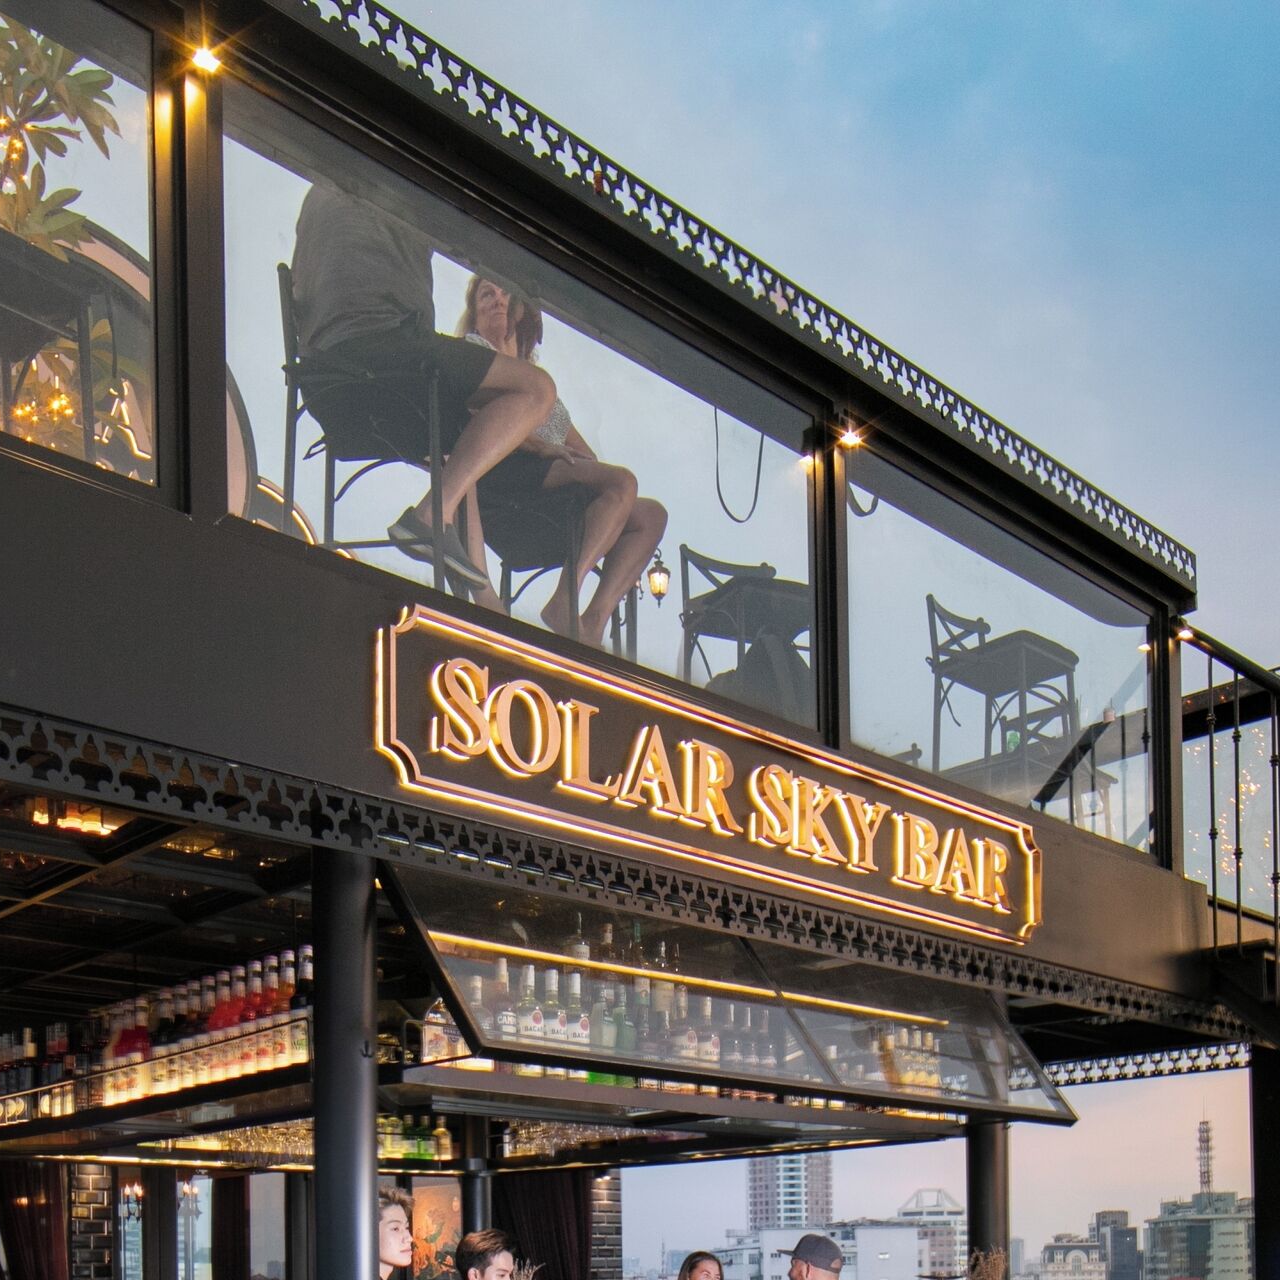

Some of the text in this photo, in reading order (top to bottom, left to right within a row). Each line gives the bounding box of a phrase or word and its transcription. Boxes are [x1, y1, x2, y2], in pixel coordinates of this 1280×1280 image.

[431, 657, 1015, 914] SOLAR SKY BAR
